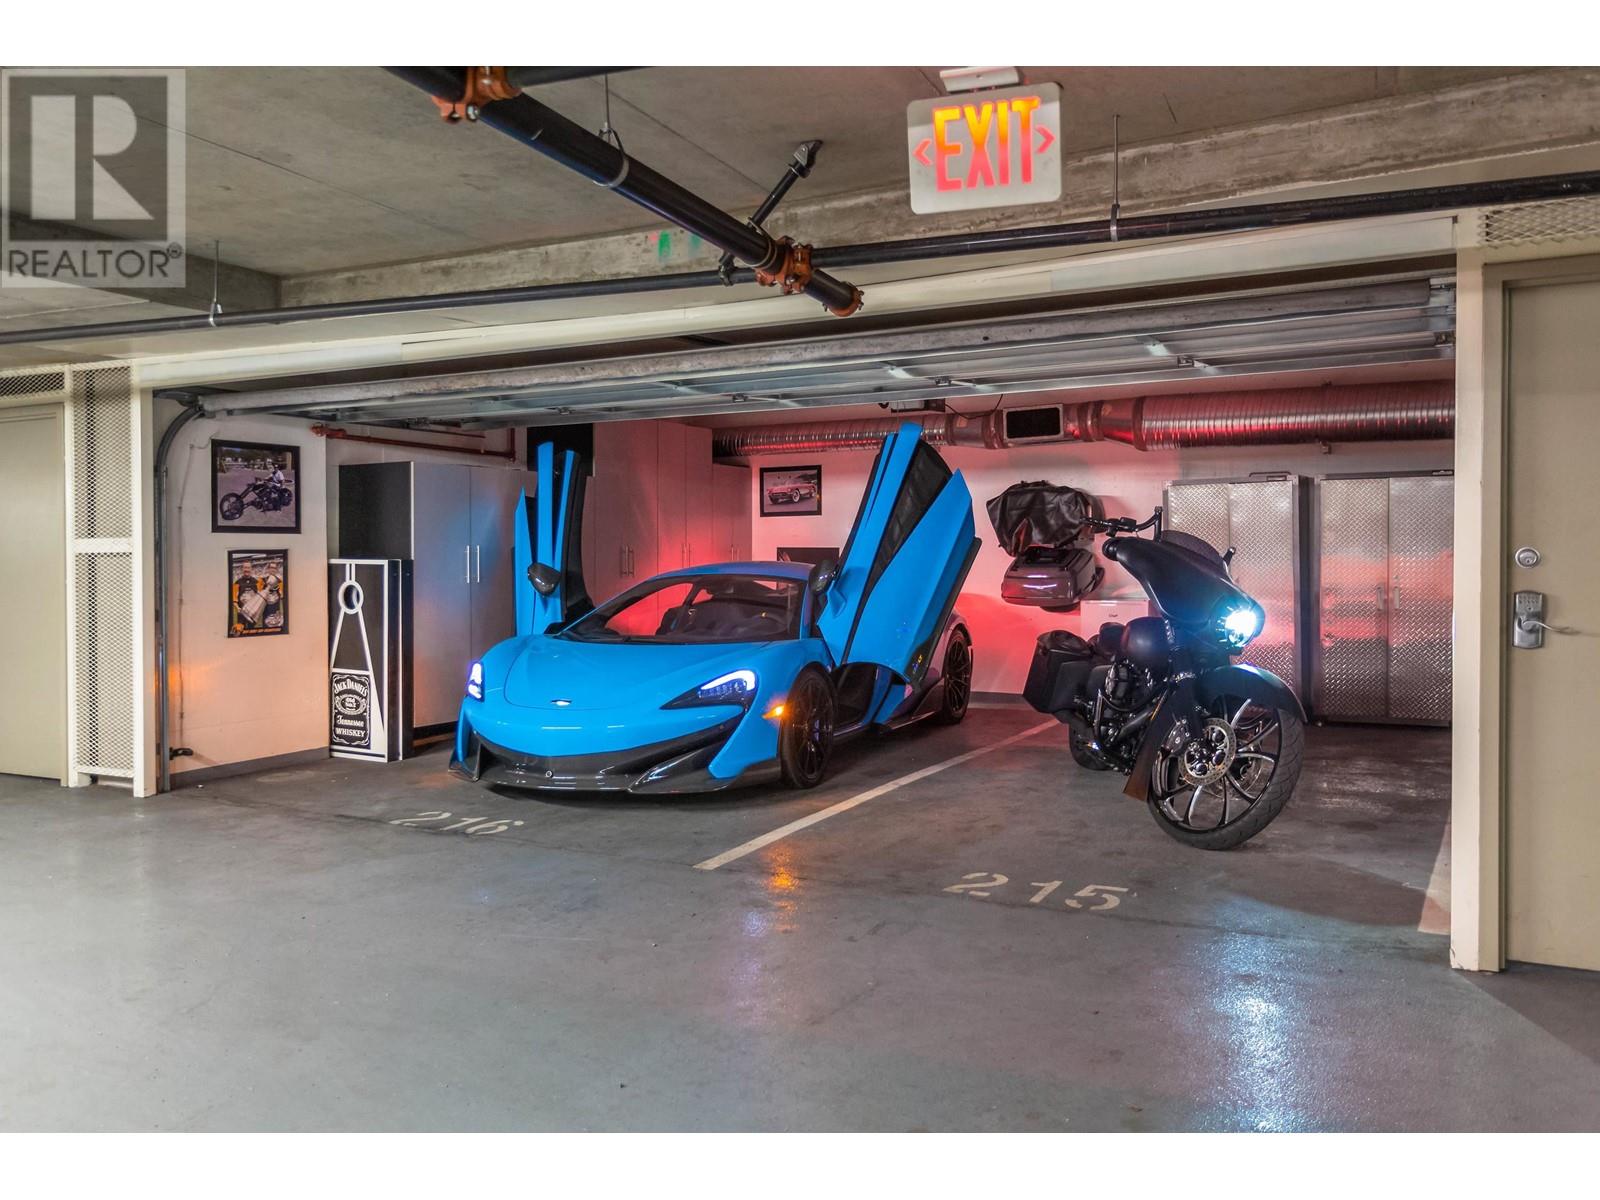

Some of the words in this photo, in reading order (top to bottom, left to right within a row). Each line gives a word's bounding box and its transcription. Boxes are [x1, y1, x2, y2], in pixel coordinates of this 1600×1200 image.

[933, 96, 1041, 192] EXIT
[335, 727, 366, 738] WHISKEY
[388, 810, 525, 836] 216
[943, 871, 1129, 911] 215
